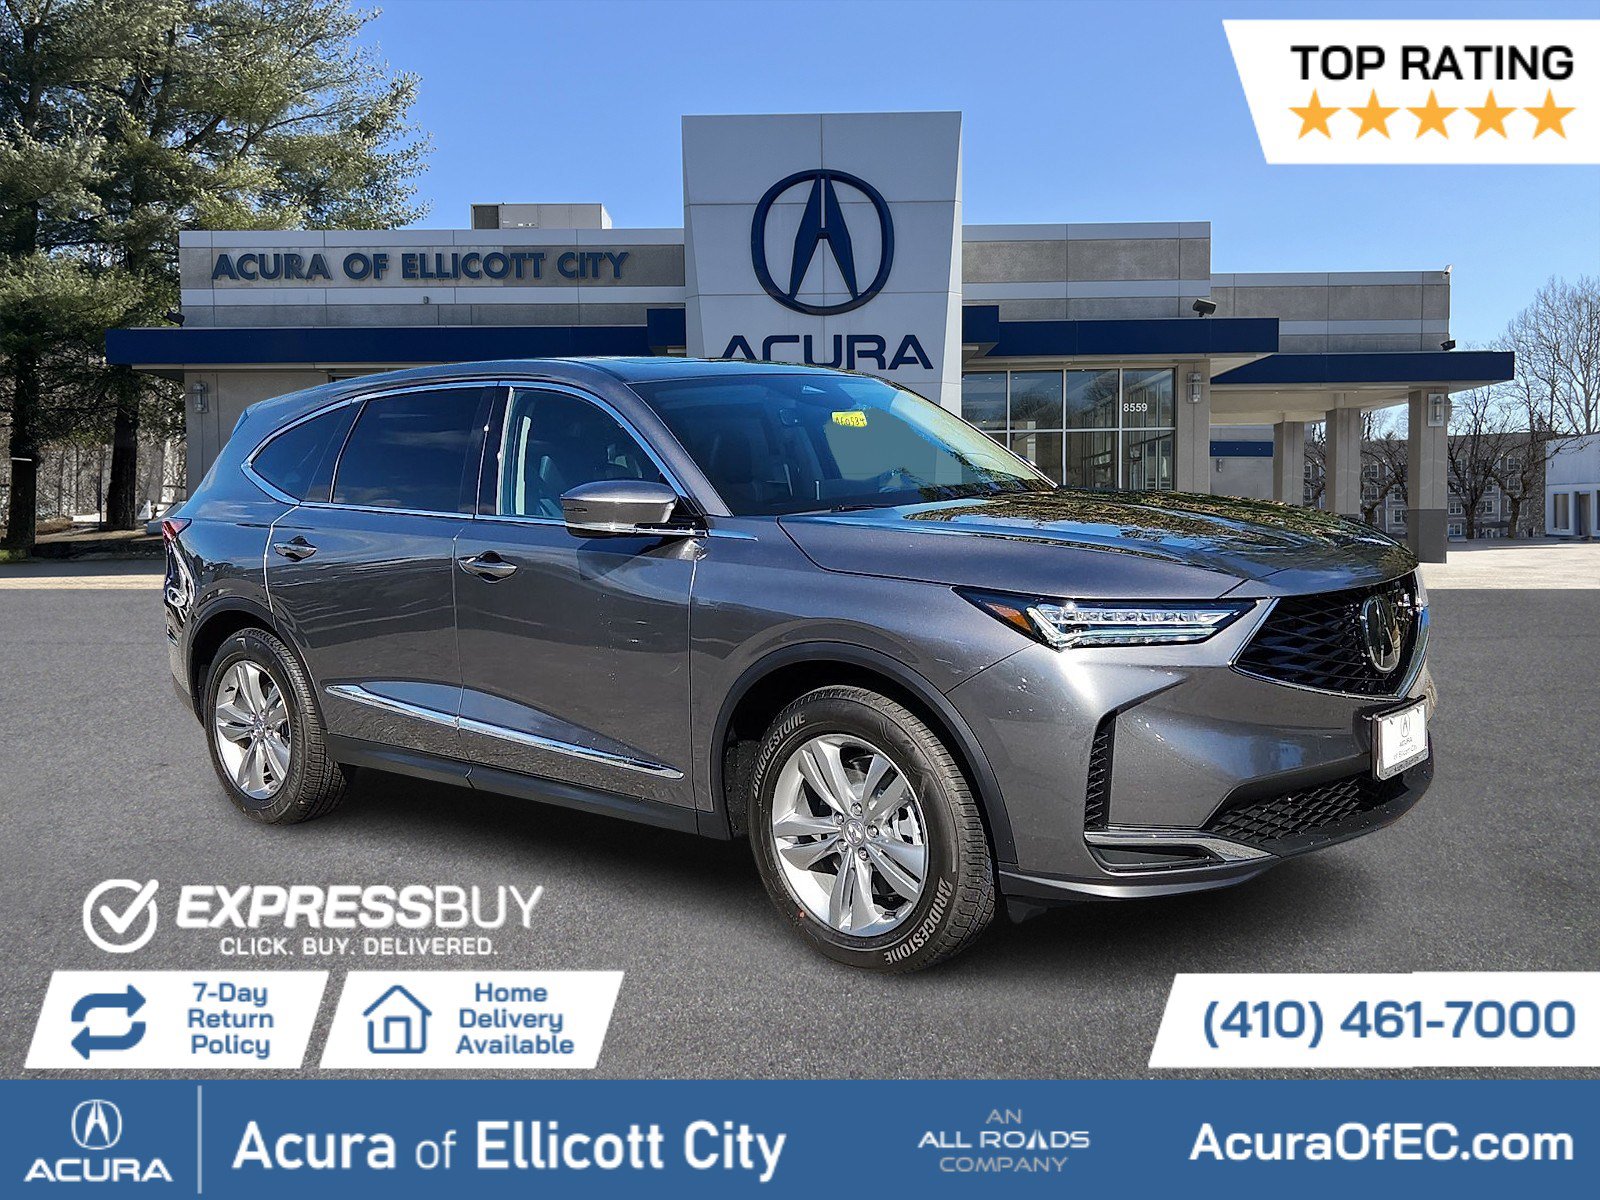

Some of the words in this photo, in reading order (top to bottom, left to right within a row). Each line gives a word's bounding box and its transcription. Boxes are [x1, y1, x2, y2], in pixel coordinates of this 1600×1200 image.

[212, 253, 332, 280] ACURA
[343, 253, 388, 280] OF
[401, 252, 545, 279] ELLICOTT
[557, 251, 629, 279] CITY
[721, 334, 934, 370] ACURA
[1123, 402, 1148, 412] 8559
[753, 712, 806, 799] BRIDGESTONE
[884, 876, 953, 965] BRIDGESTONE
